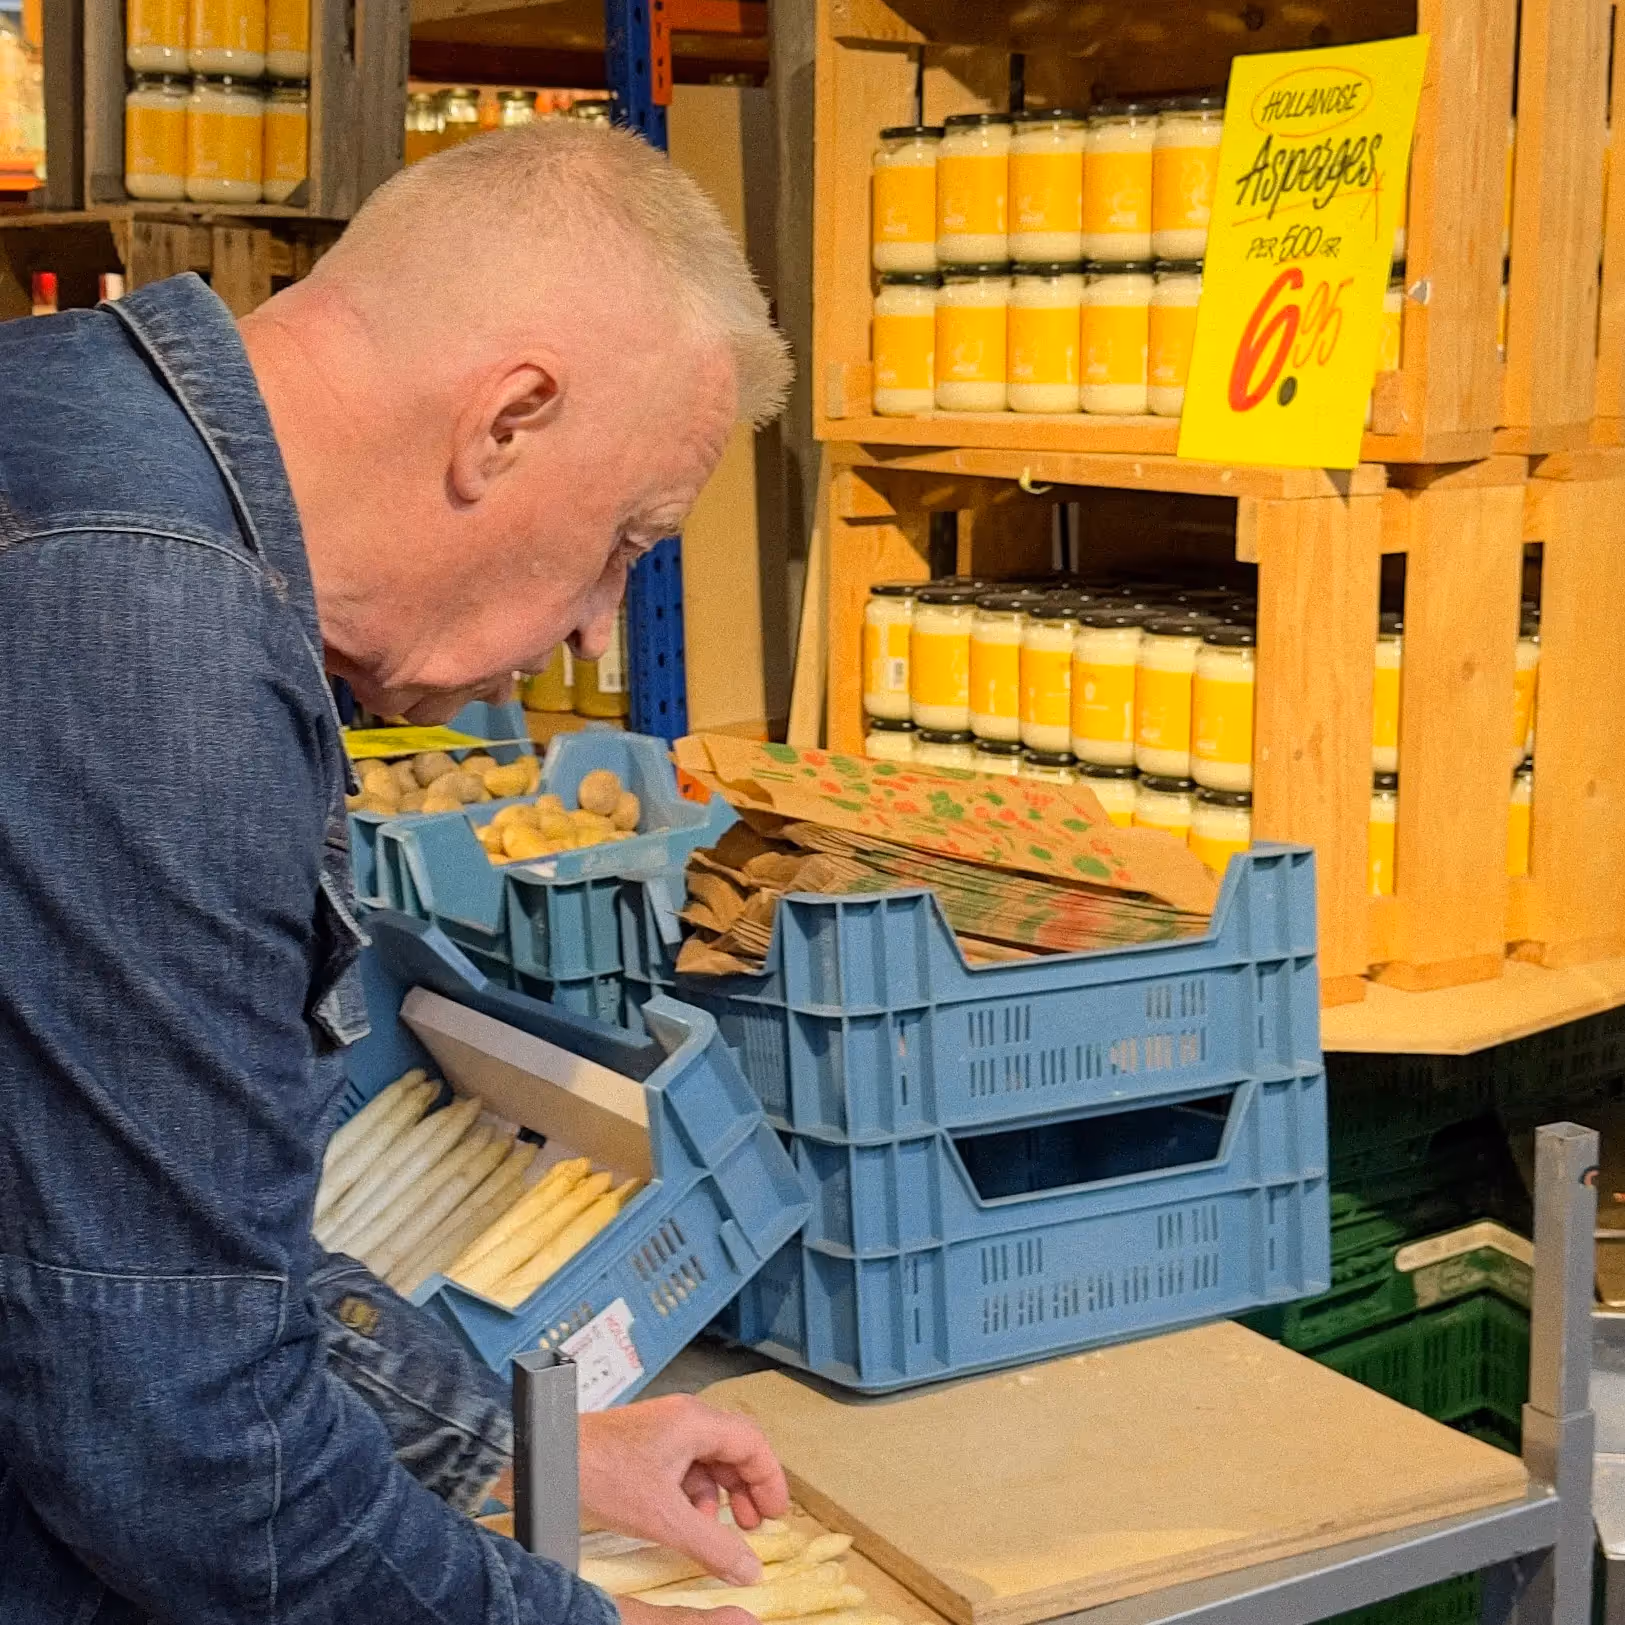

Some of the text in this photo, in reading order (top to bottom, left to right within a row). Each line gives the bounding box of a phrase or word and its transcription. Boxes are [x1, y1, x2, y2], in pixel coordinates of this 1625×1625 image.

[1261, 82, 1362, 122] HOLLANDSE
[1236, 133, 1383, 220] Asperges
[1246, 236, 1278, 260] PER
[1279, 224, 1323, 262] 500
